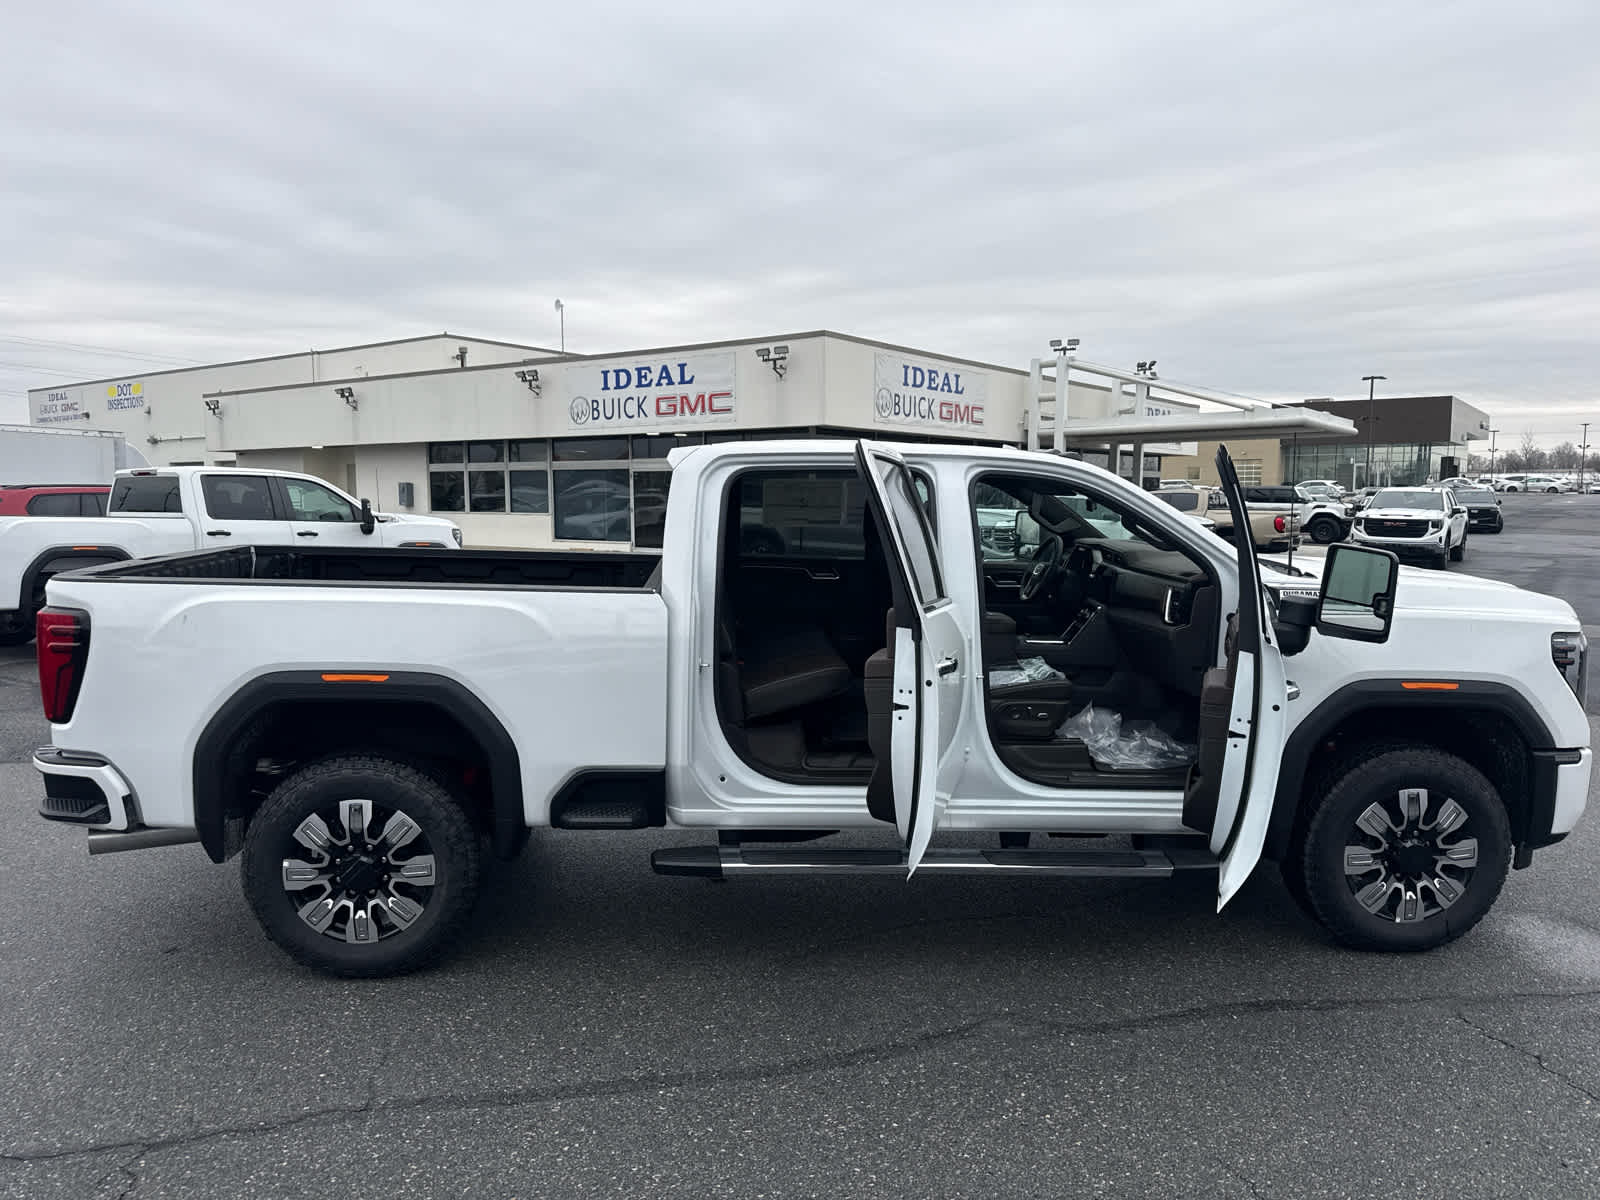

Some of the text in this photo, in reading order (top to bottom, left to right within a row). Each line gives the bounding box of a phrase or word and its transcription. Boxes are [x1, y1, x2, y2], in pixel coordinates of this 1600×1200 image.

[601, 362, 695, 391] IDEAL
[902, 364, 965, 395] IDEAL
[48, 392, 68, 402] IDEAL
[117, 383, 132, 397] DOT
[61, 402, 79, 412] GMC
[107, 396, 144, 410] INSPECTIONS
[592, 391, 733, 420] BUICK GMC
[893, 393, 985, 425] BUICK GMC
